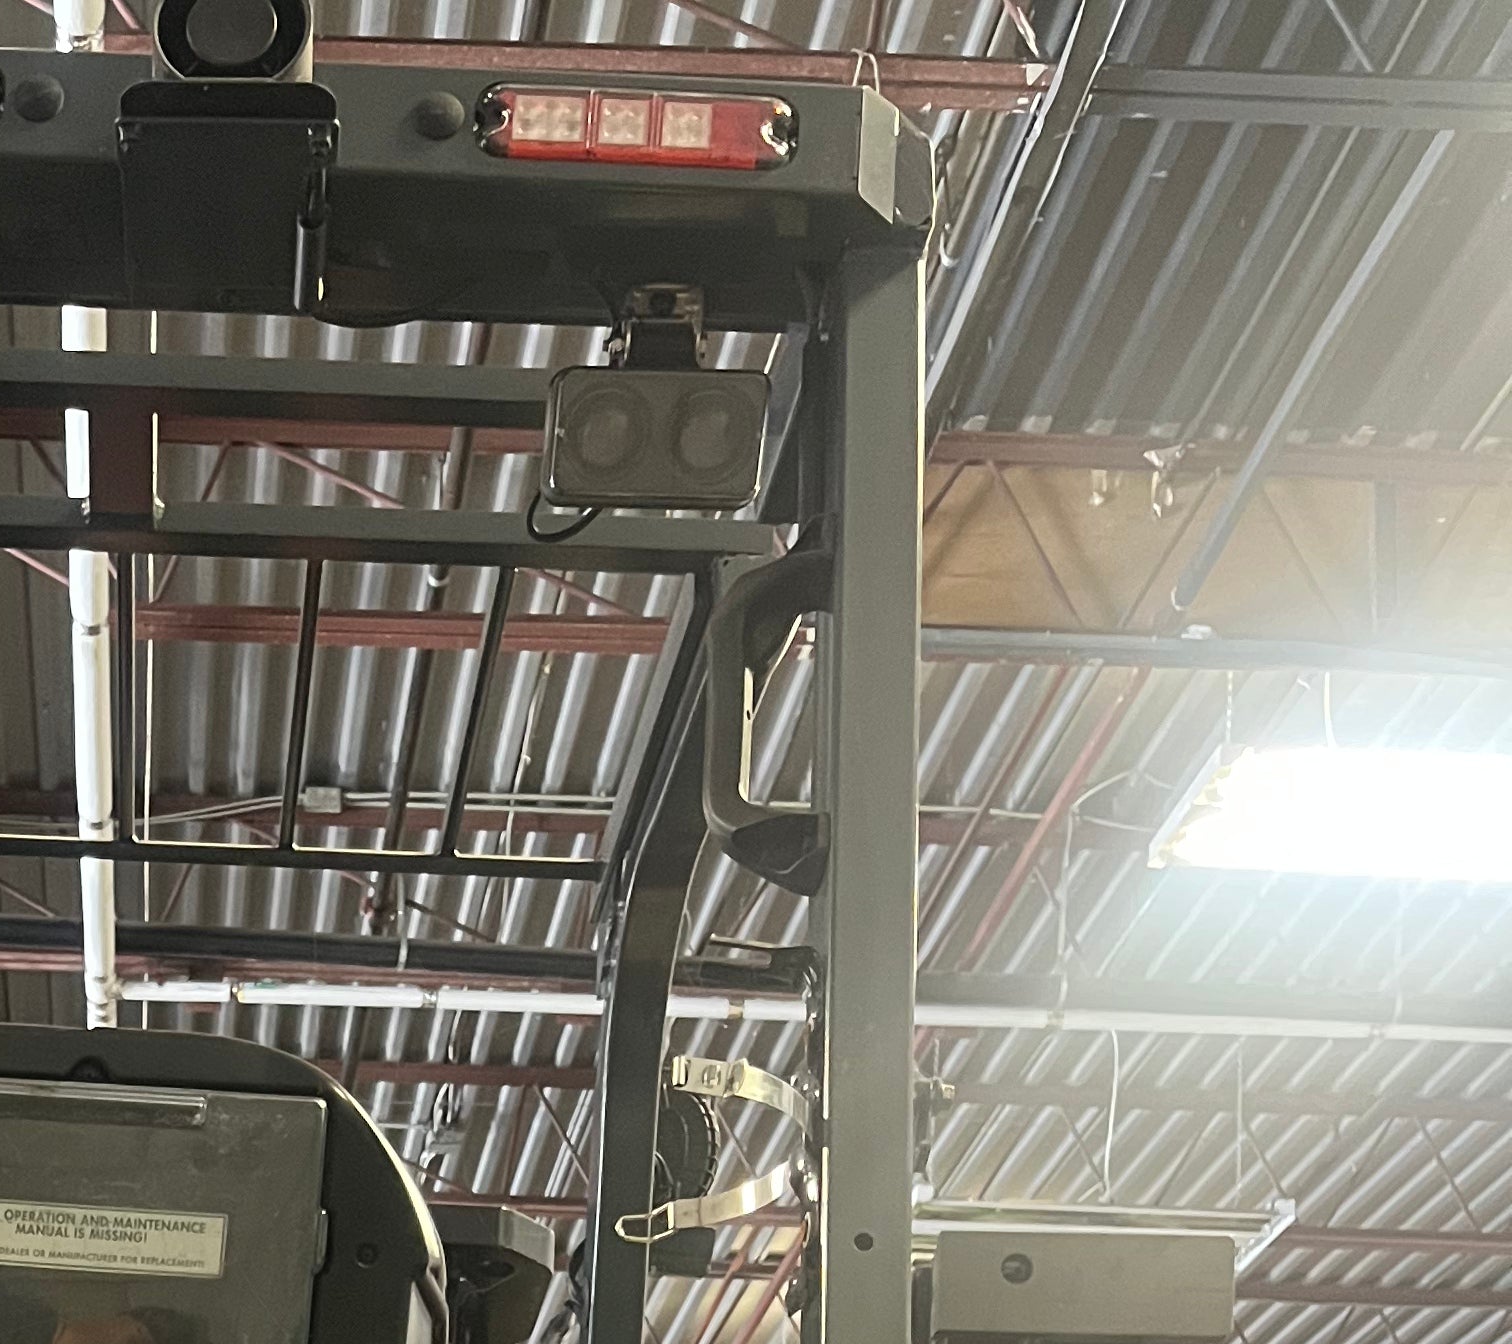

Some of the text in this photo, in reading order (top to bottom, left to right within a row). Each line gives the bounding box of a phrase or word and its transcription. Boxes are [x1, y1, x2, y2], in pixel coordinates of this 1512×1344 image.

[4, 1208, 76, 1225] OPERATION
[80, 1214, 109, 1228] AND
[112, 1216, 207, 1234] MAINTENANCE
[15, 1223, 70, 1238] MANUAL
[74, 1227, 85, 1239] IS
[32, 1249, 46, 1258] OR
[48, 1250, 118, 1263] MANUFACTURER
[121, 1255, 138, 1264] FOR
